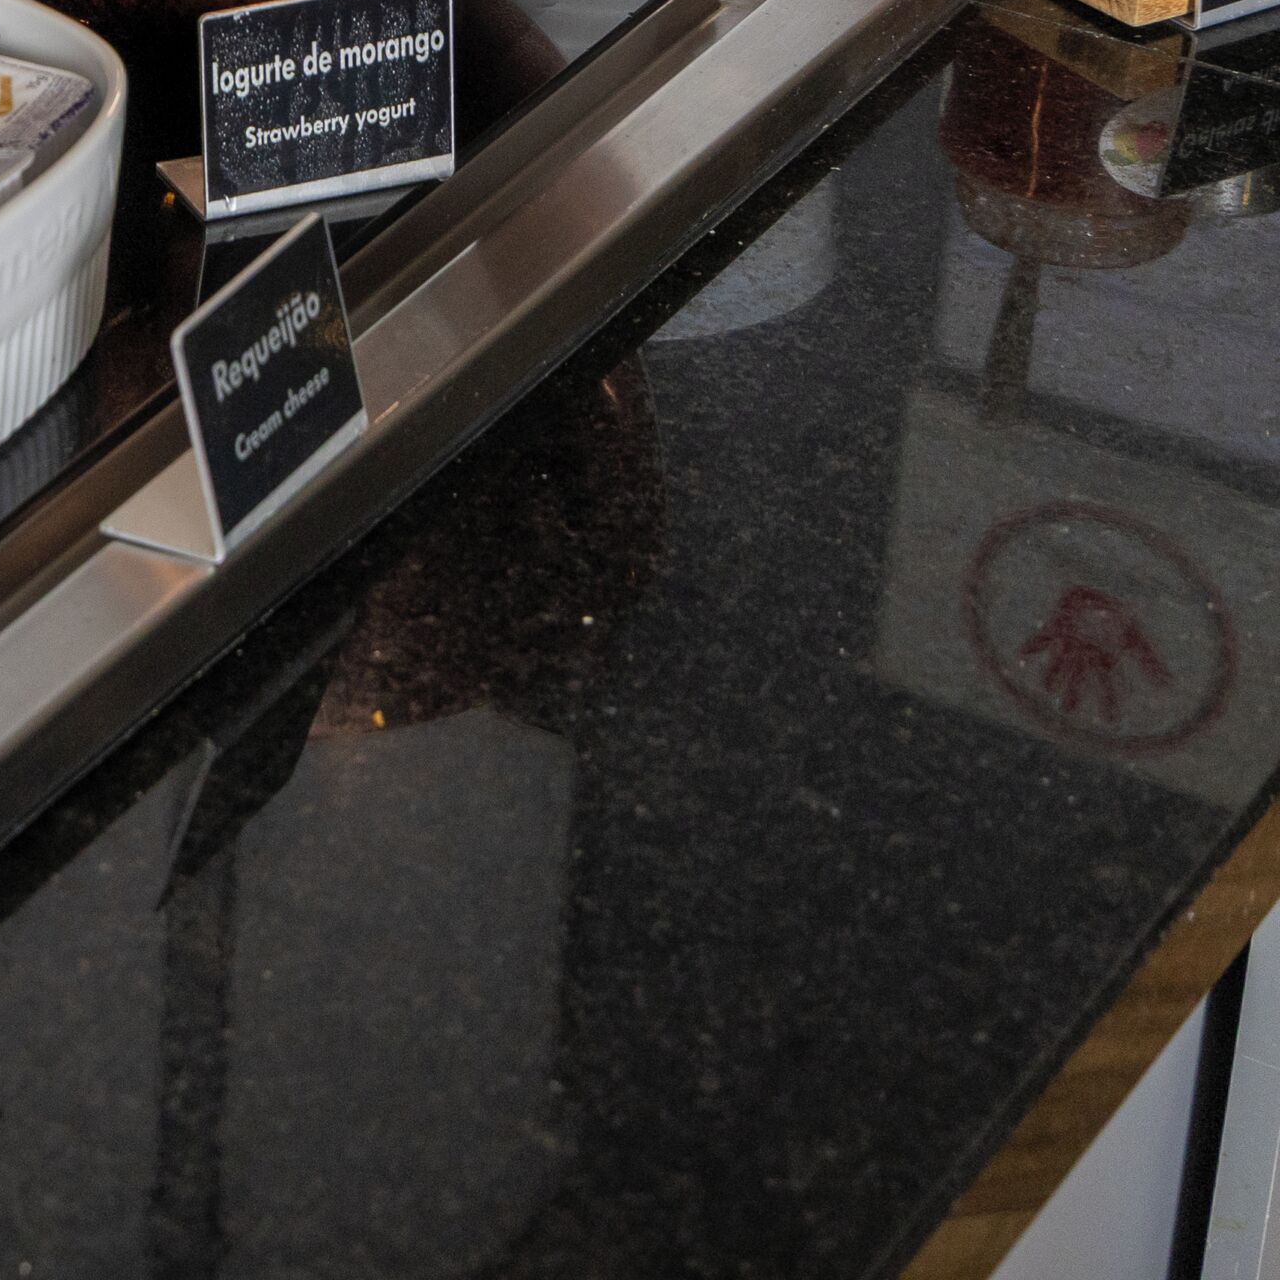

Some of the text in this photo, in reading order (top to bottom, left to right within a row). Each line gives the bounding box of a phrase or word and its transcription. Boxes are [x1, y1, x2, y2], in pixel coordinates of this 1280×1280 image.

[212, 29, 445, 98] Iogurte de morango
[245, 98, 416, 148] Strawberry yogurt
[211, 290, 321, 403] Requeijão
[234, 366, 330, 462] Cream cheese
